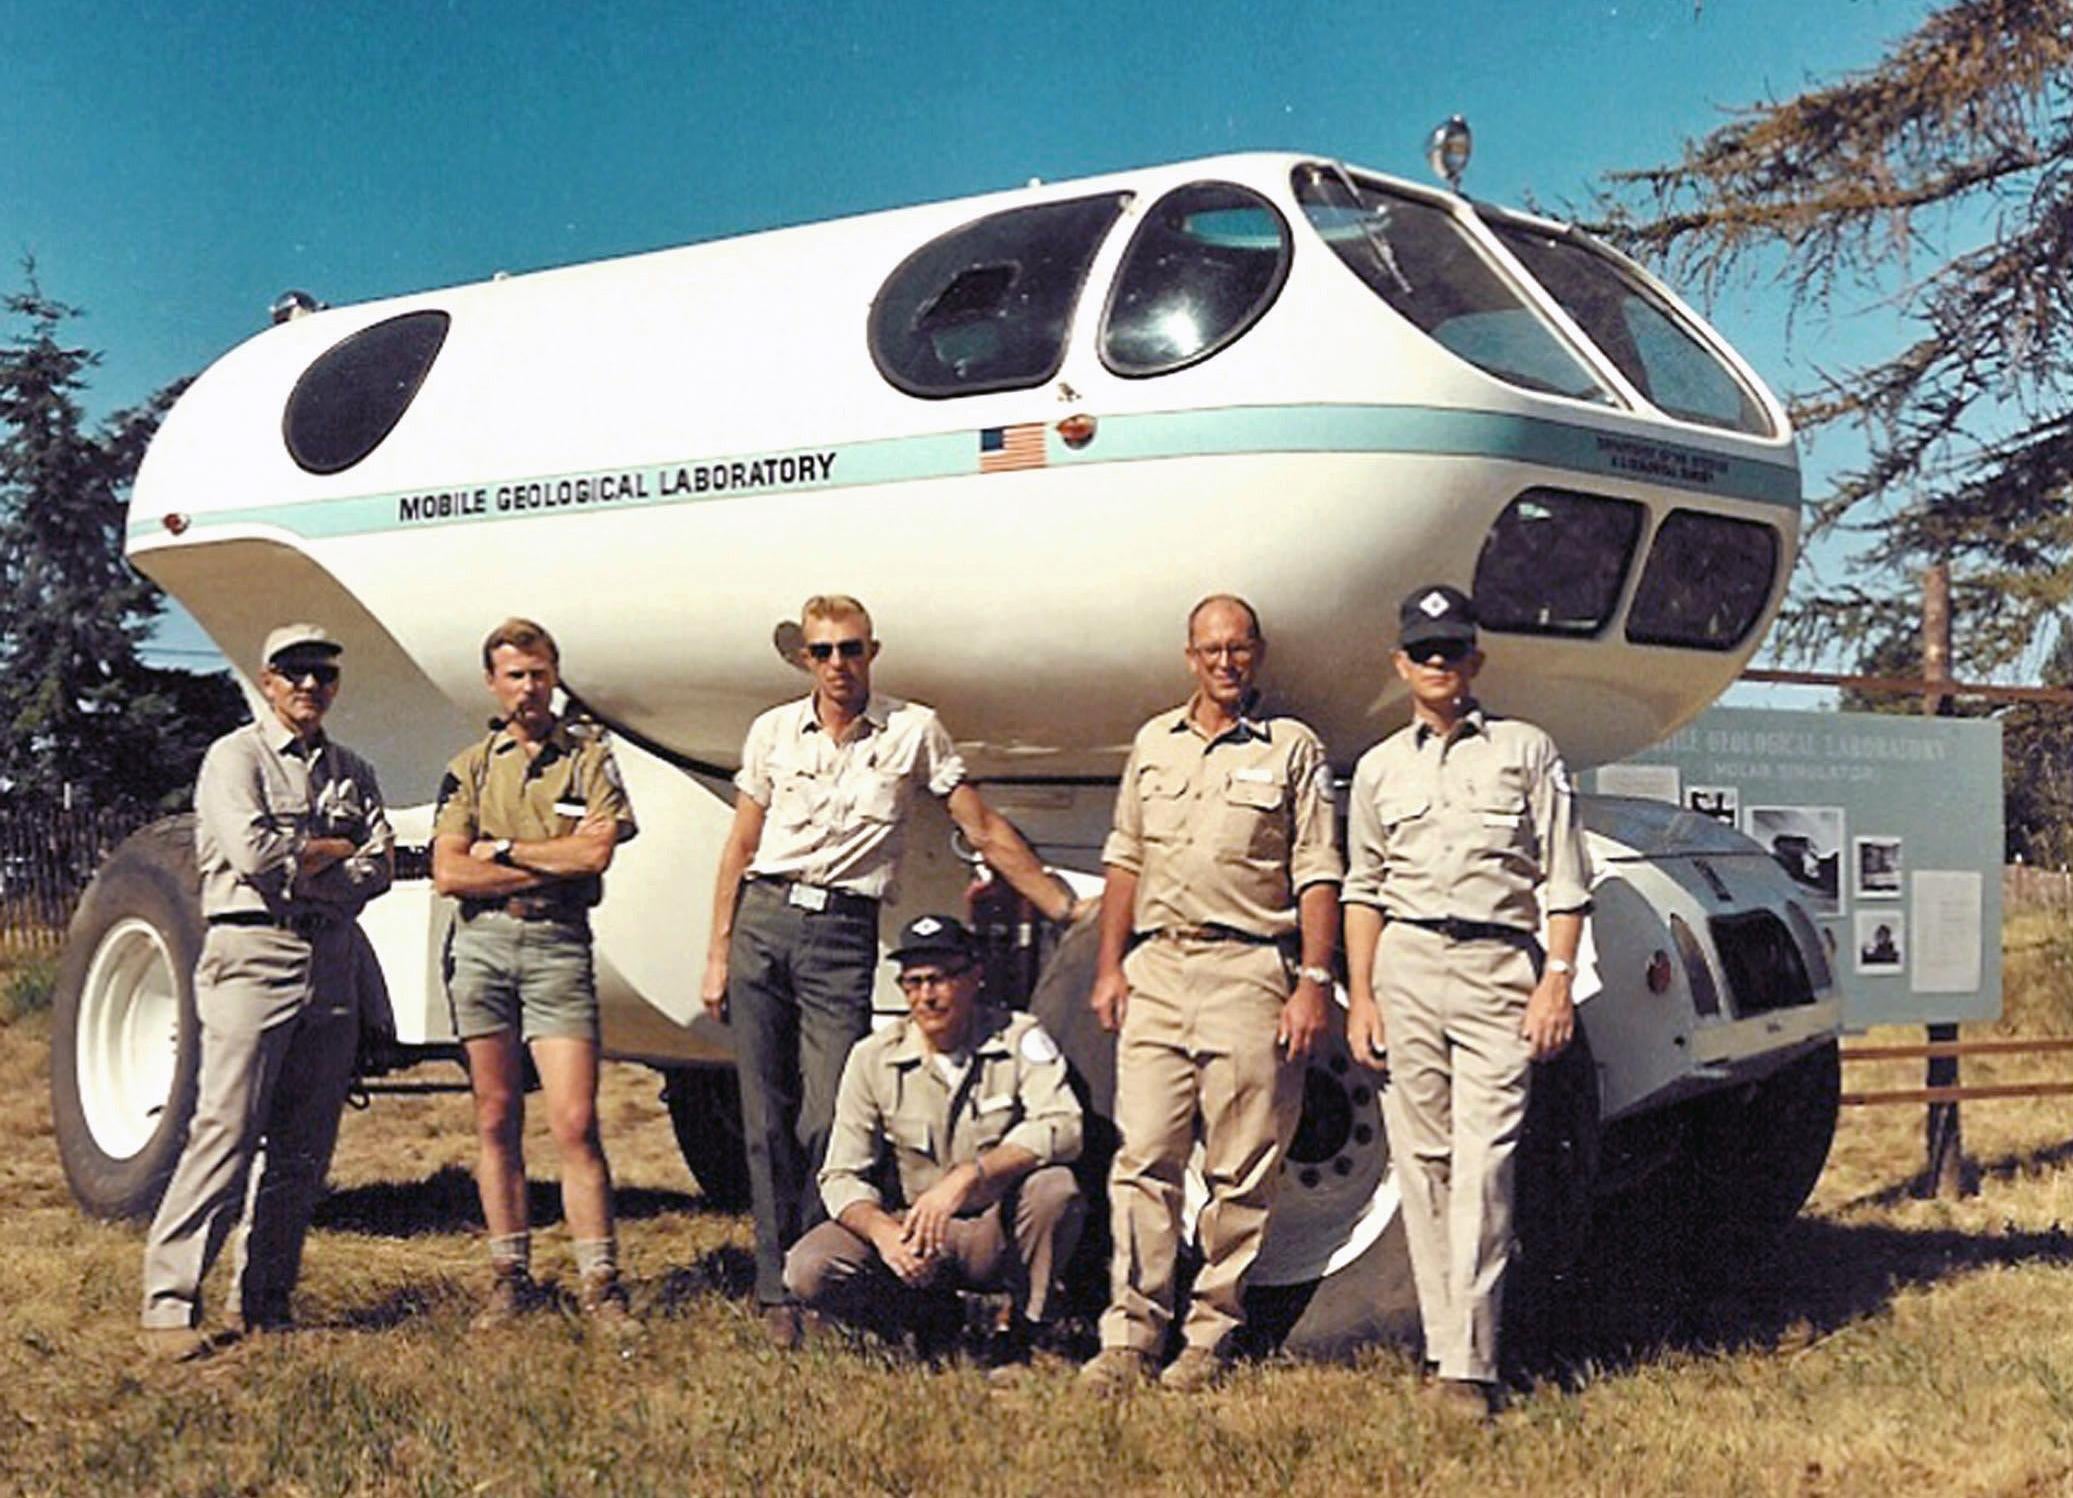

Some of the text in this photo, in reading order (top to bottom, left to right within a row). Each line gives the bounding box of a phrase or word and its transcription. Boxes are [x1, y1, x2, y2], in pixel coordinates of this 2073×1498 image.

[400, 452, 837, 521] MOBILE GEOLOGICAL LABORATORY
[1707, 729, 1814, 756] GEOLOGICAL
[1823, 733, 1947, 761] LABORATORY
